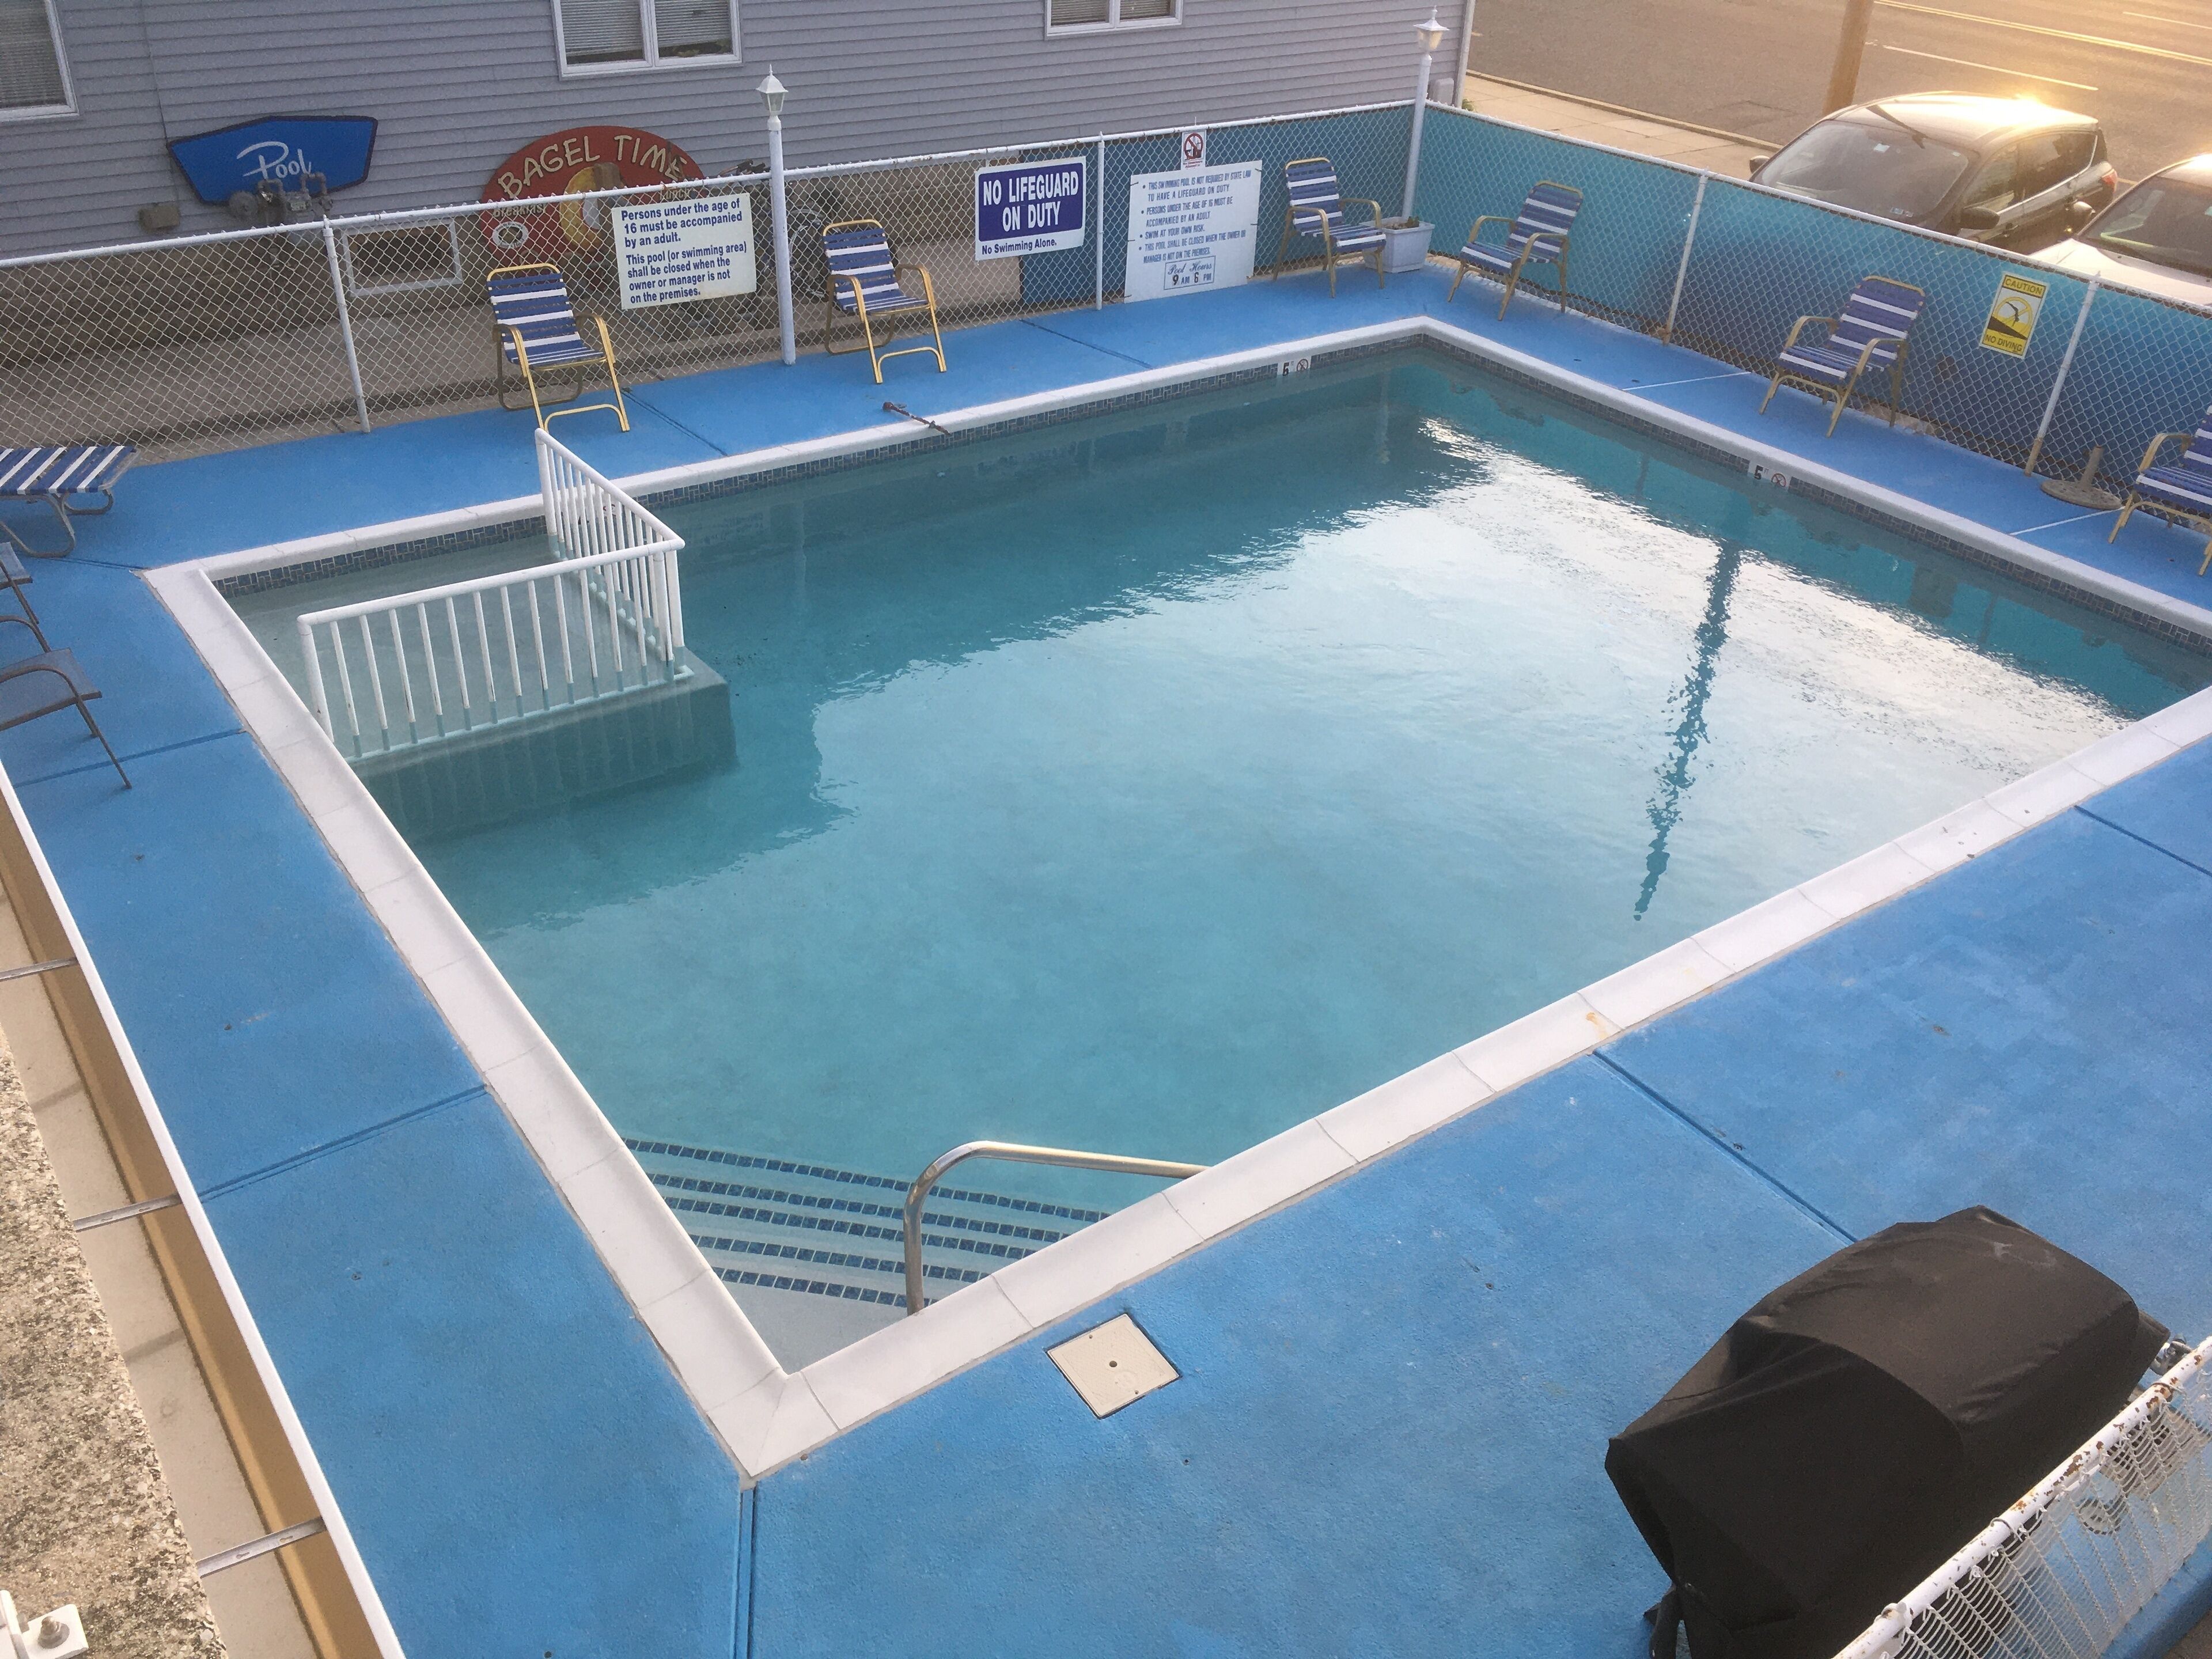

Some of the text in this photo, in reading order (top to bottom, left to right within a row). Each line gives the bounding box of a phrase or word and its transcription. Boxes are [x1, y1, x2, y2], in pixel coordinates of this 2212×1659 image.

[236, 141, 312, 179] Pool
[498, 135, 688, 199] BAGEL TIME
[983, 171, 1079, 206] NO LIFEGUARD
[1148, 184, 1229, 202] TO HAVE A LIFEGUARD ON DUTY
[622, 198, 740, 221] Persons under the age of
[1002, 201, 1060, 232] ON DUTY
[624, 211, 743, 234] 16 must be accompanied
[1146, 215, 1179, 227] ACCOMPANIED
[1188, 214, 1195, 222] AN
[1196, 211, 1210, 220] ADULT
[624, 232, 681, 249] by an adult.
[1145, 230, 1158, 239] SWIM
[1160, 229, 1166, 237] AT
[1168, 228, 1180, 236] YOUR
[1181, 226, 1192, 234] OWN
[626, 241, 747, 265] This pool (or swimming area)
[982, 238, 1057, 255] No Swimming Alone.
[628, 257, 730, 278] shall be closed when the
[1168, 261, 1212, 275] Pool Hours
[629, 269, 730, 291] owner or manager is not
[1172, 272, 1212, 285] 9 AM 6 PM
[2005, 279, 2043, 295] CAUTION
[630, 288, 701, 304] on the premises.
[1985, 335, 2022, 351] NO DIVING
[1754, 465, 1763, 480] 5
